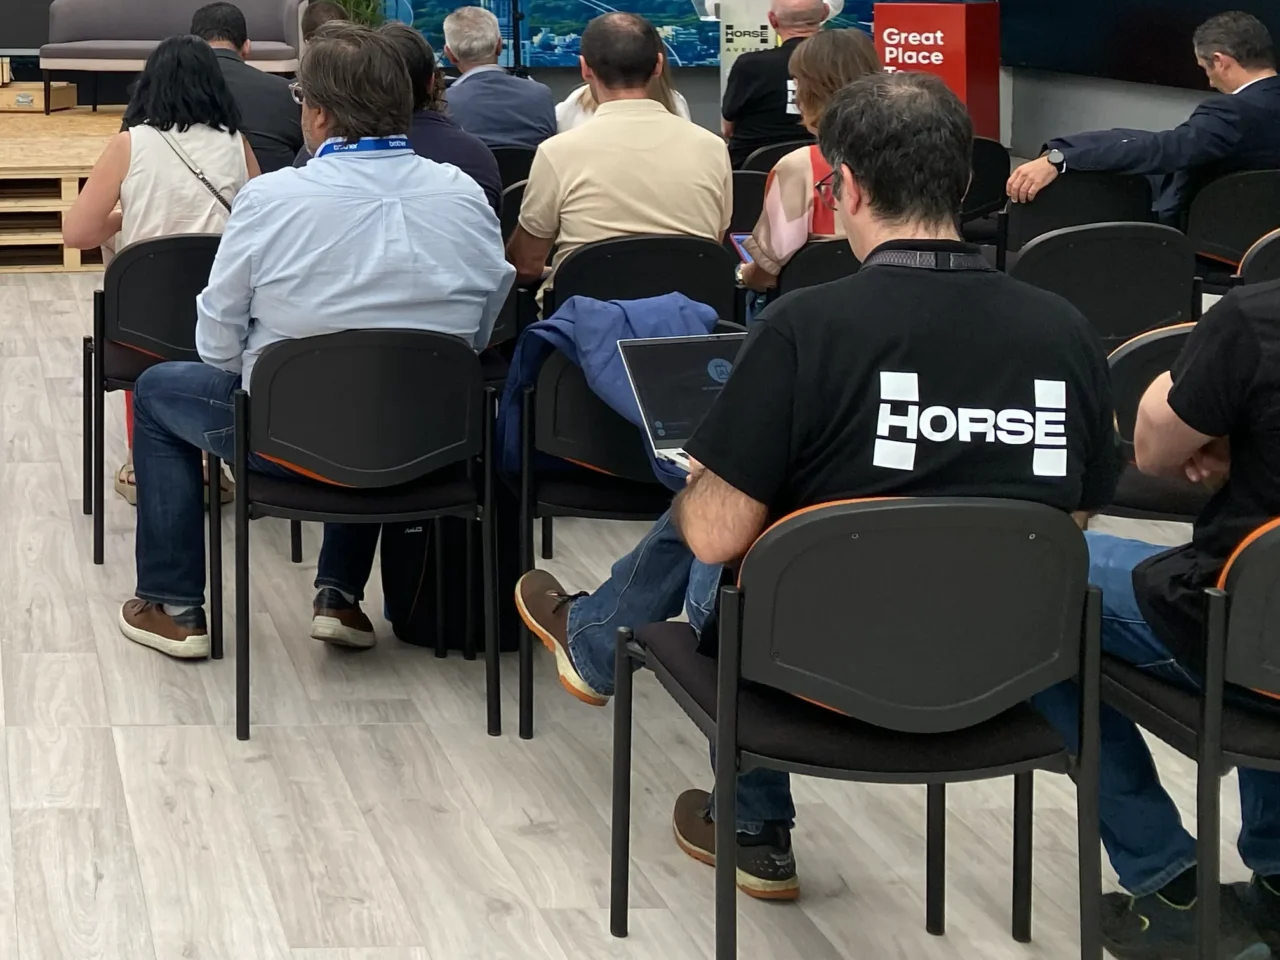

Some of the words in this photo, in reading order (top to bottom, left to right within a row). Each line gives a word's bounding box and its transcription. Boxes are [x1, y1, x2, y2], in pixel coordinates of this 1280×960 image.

[882, 28, 945, 45] Great
[884, 47, 944, 64] Place
[875, 403, 1067, 446] HORSE
